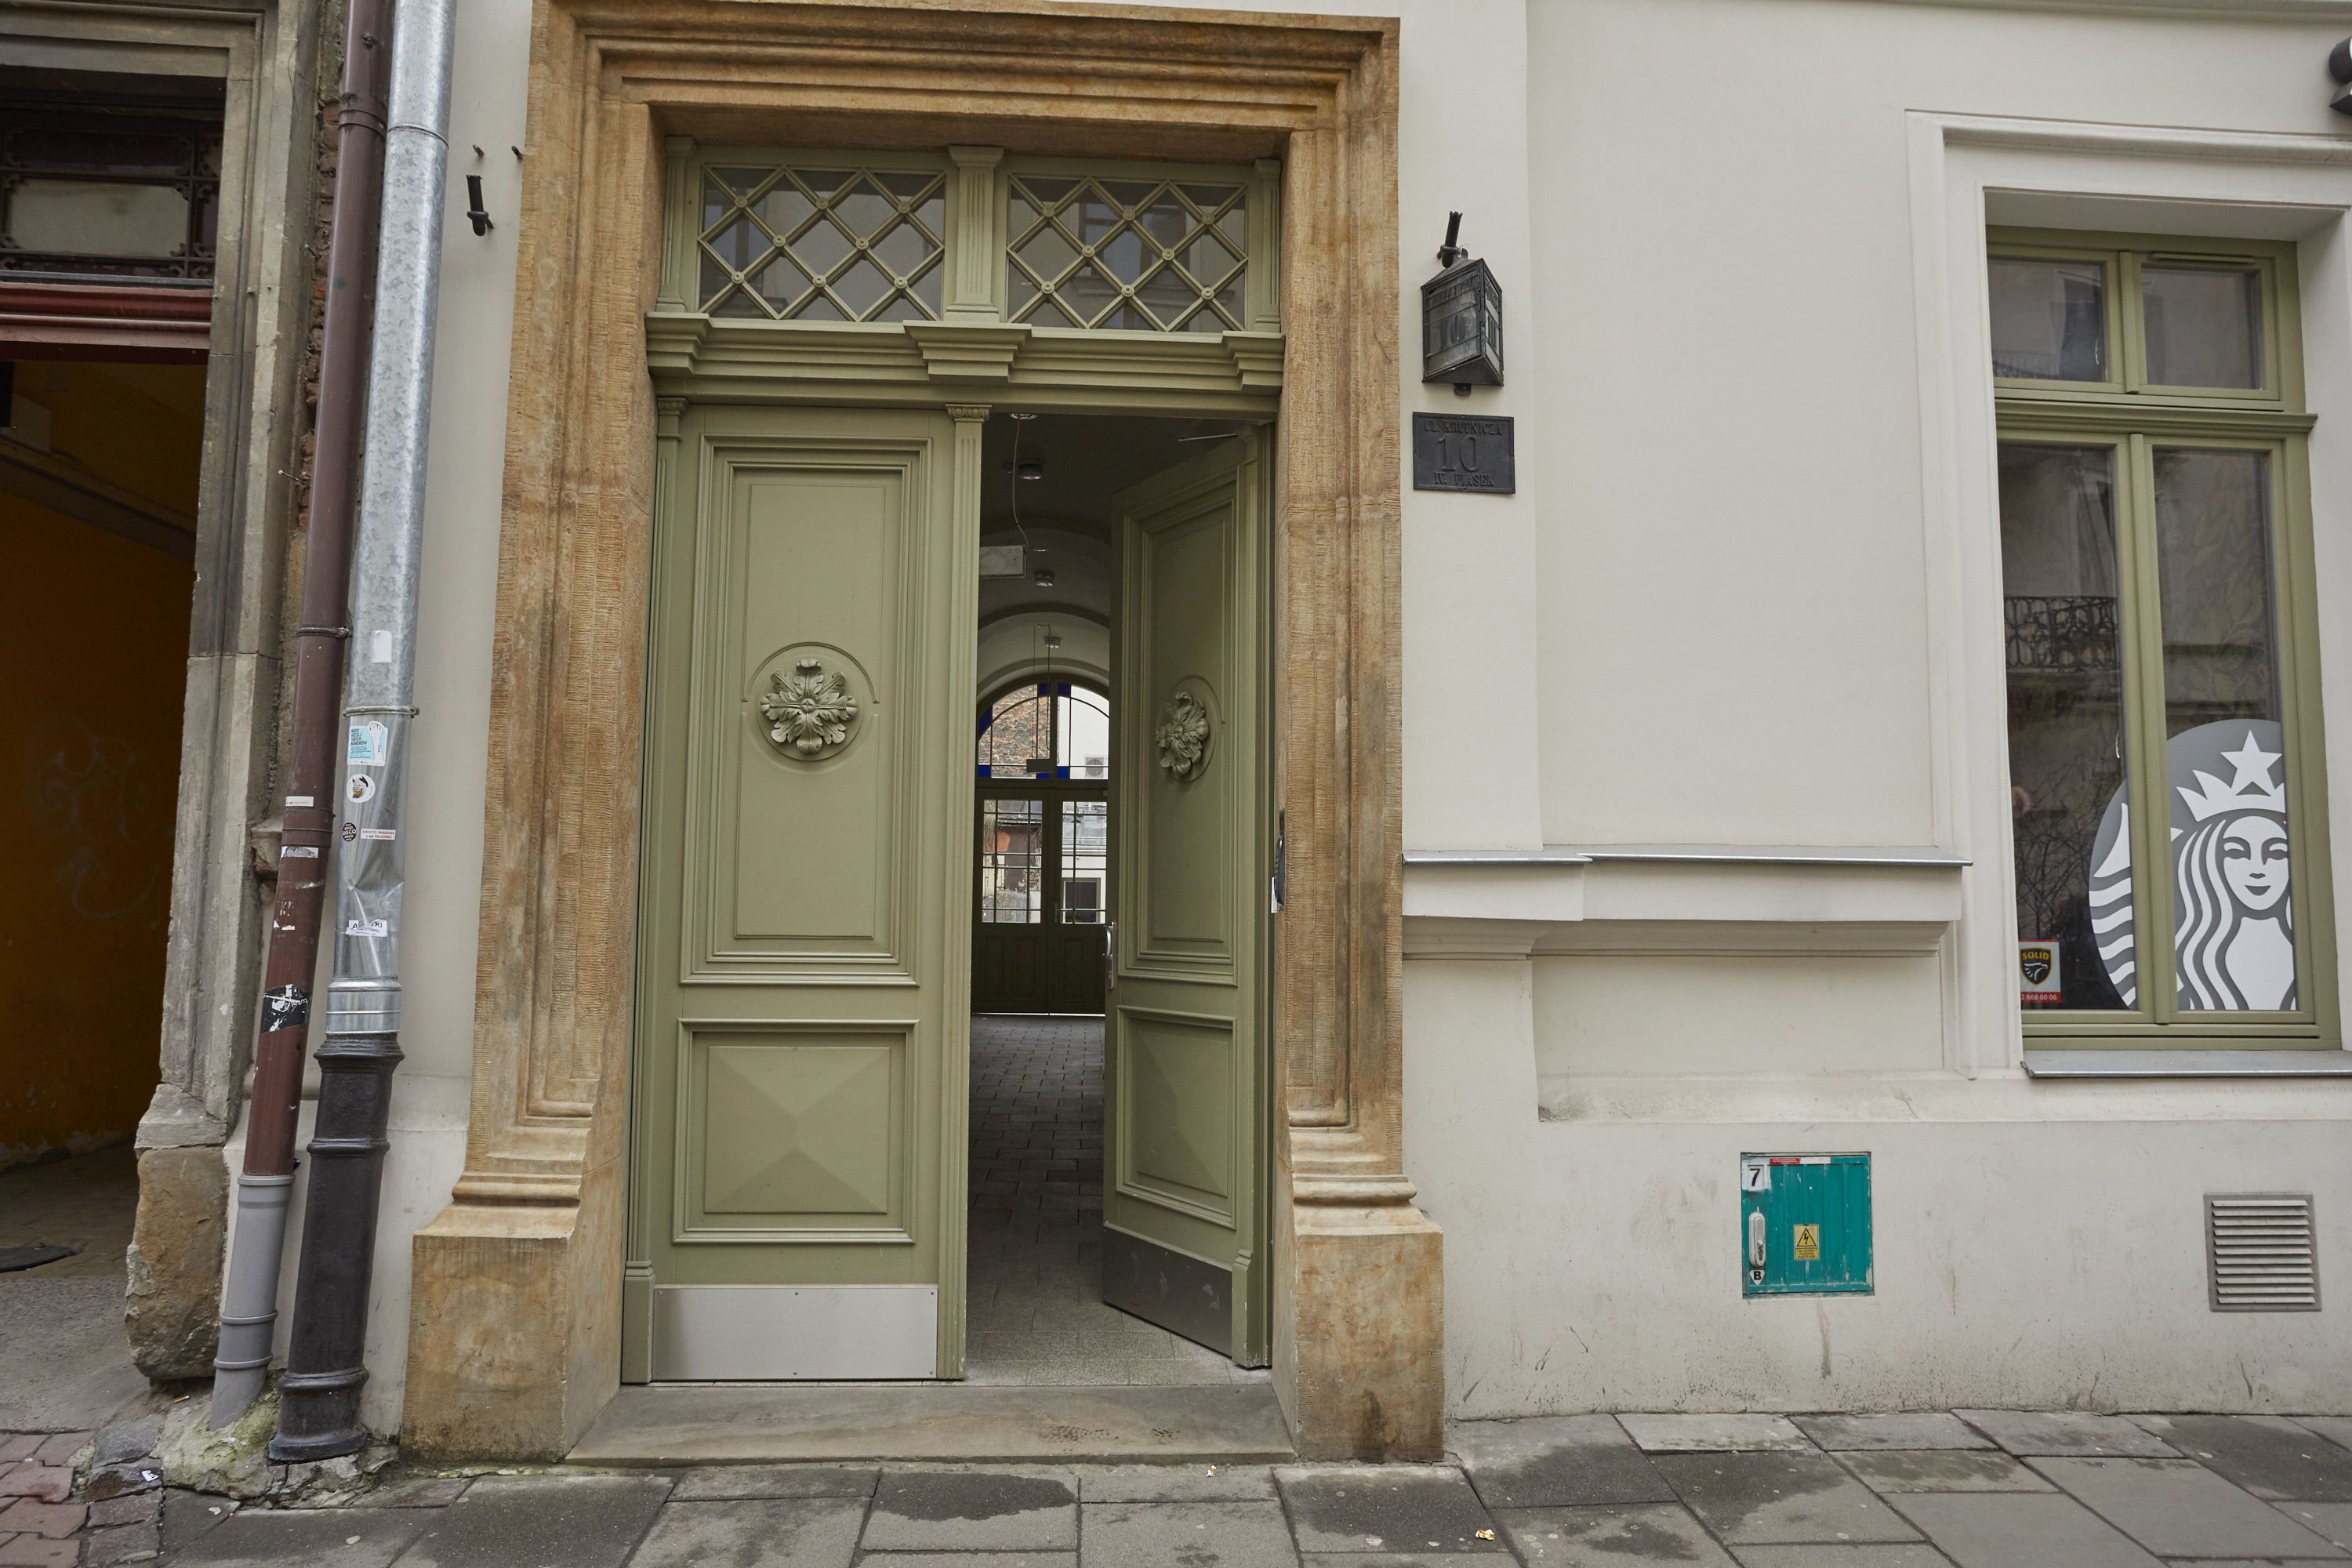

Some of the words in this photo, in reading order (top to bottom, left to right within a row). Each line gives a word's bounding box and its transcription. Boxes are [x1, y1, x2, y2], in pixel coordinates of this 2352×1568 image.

[1437, 433, 1481, 473] 10
[1749, 1168, 1761, 1186] 7
[1753, 1271, 1762, 1281] B
